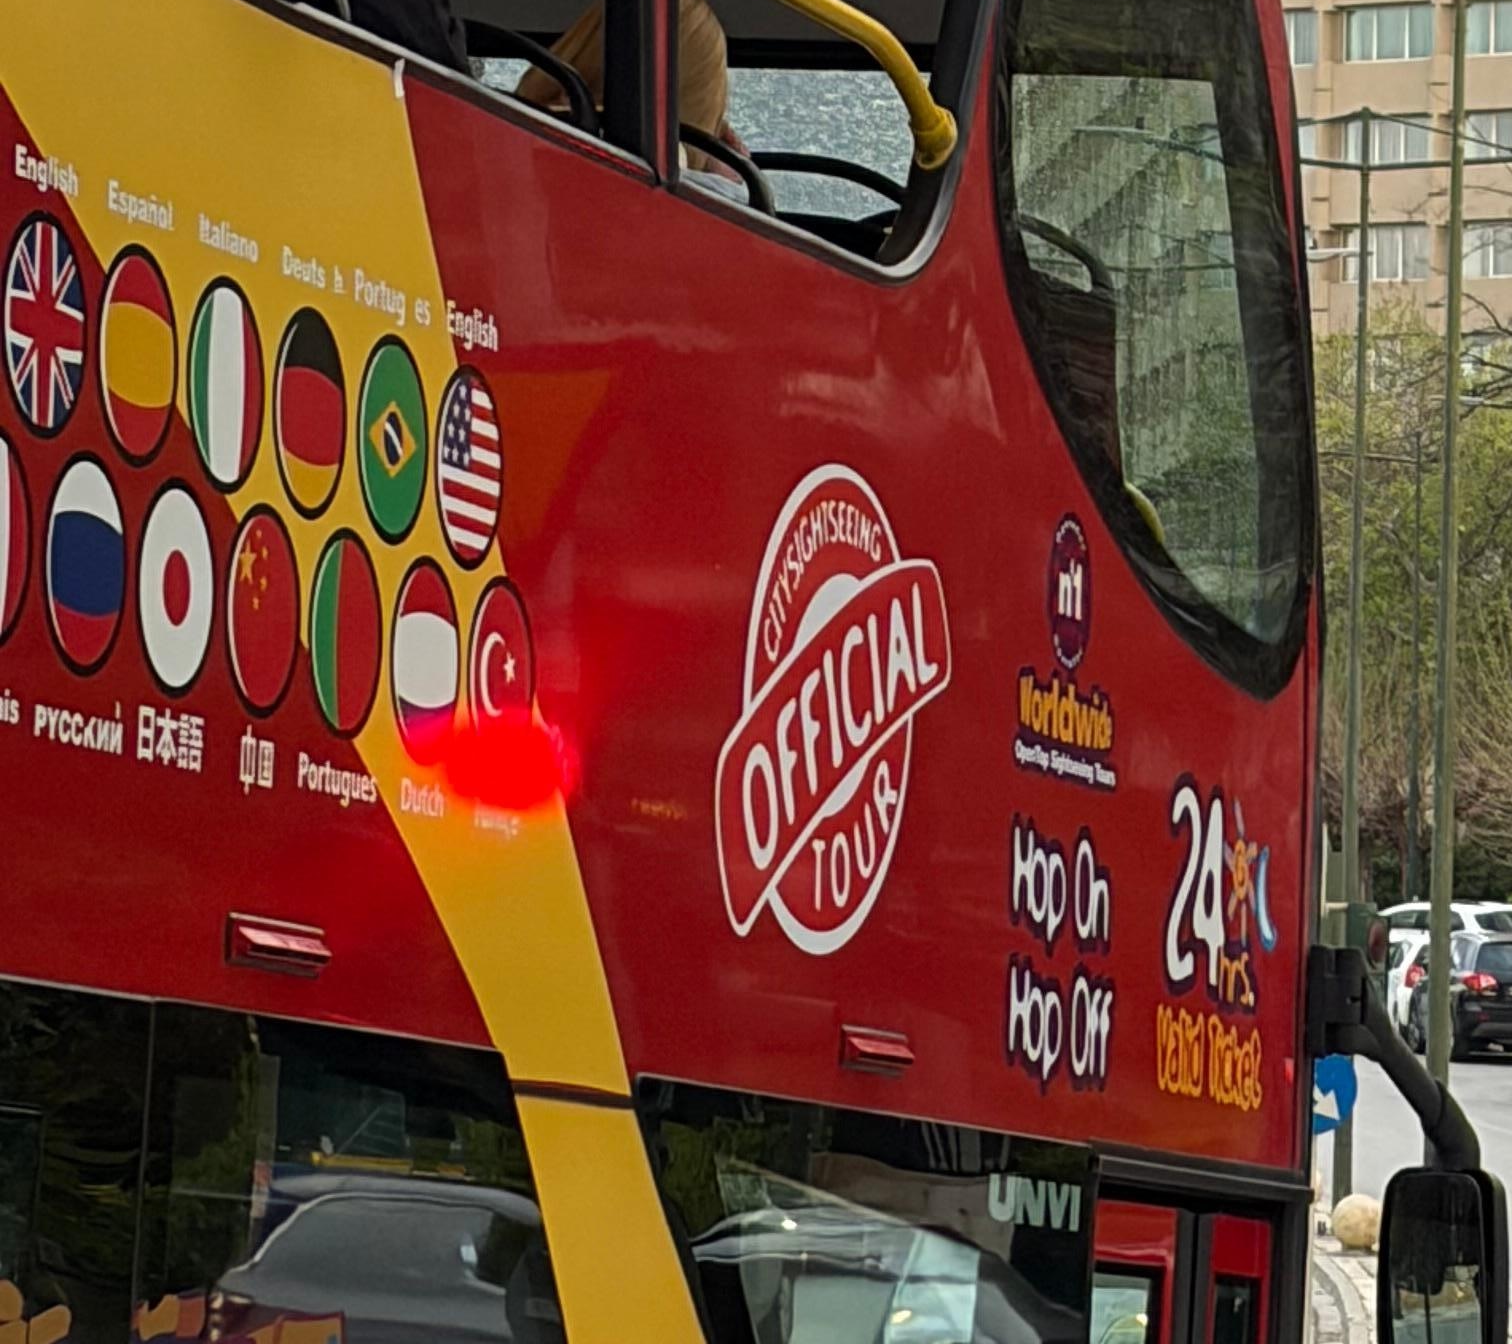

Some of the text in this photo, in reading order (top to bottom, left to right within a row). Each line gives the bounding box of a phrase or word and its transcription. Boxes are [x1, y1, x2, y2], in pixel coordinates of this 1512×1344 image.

[15, 144, 79, 197] English
[107, 179, 175, 232] Español
[447, 299, 498, 351] English
[763, 500, 882, 662] CITYSIGHTSEEING
[137, 705, 205, 773] 日本語
[742, 582, 938, 870] OFFICIAL
[1019, 674, 1112, 750] Worldwide
[400, 777, 445, 817] Dutch
[812, 759, 898, 913] TOUR
[1013, 826, 1110, 942] Hop On
[1165, 786, 1226, 987] 24
[1008, 966, 1113, 1081] Hop Off
[1157, 1004, 1205, 1098] Valid
[988, 1173, 1082, 1233] UNVI
